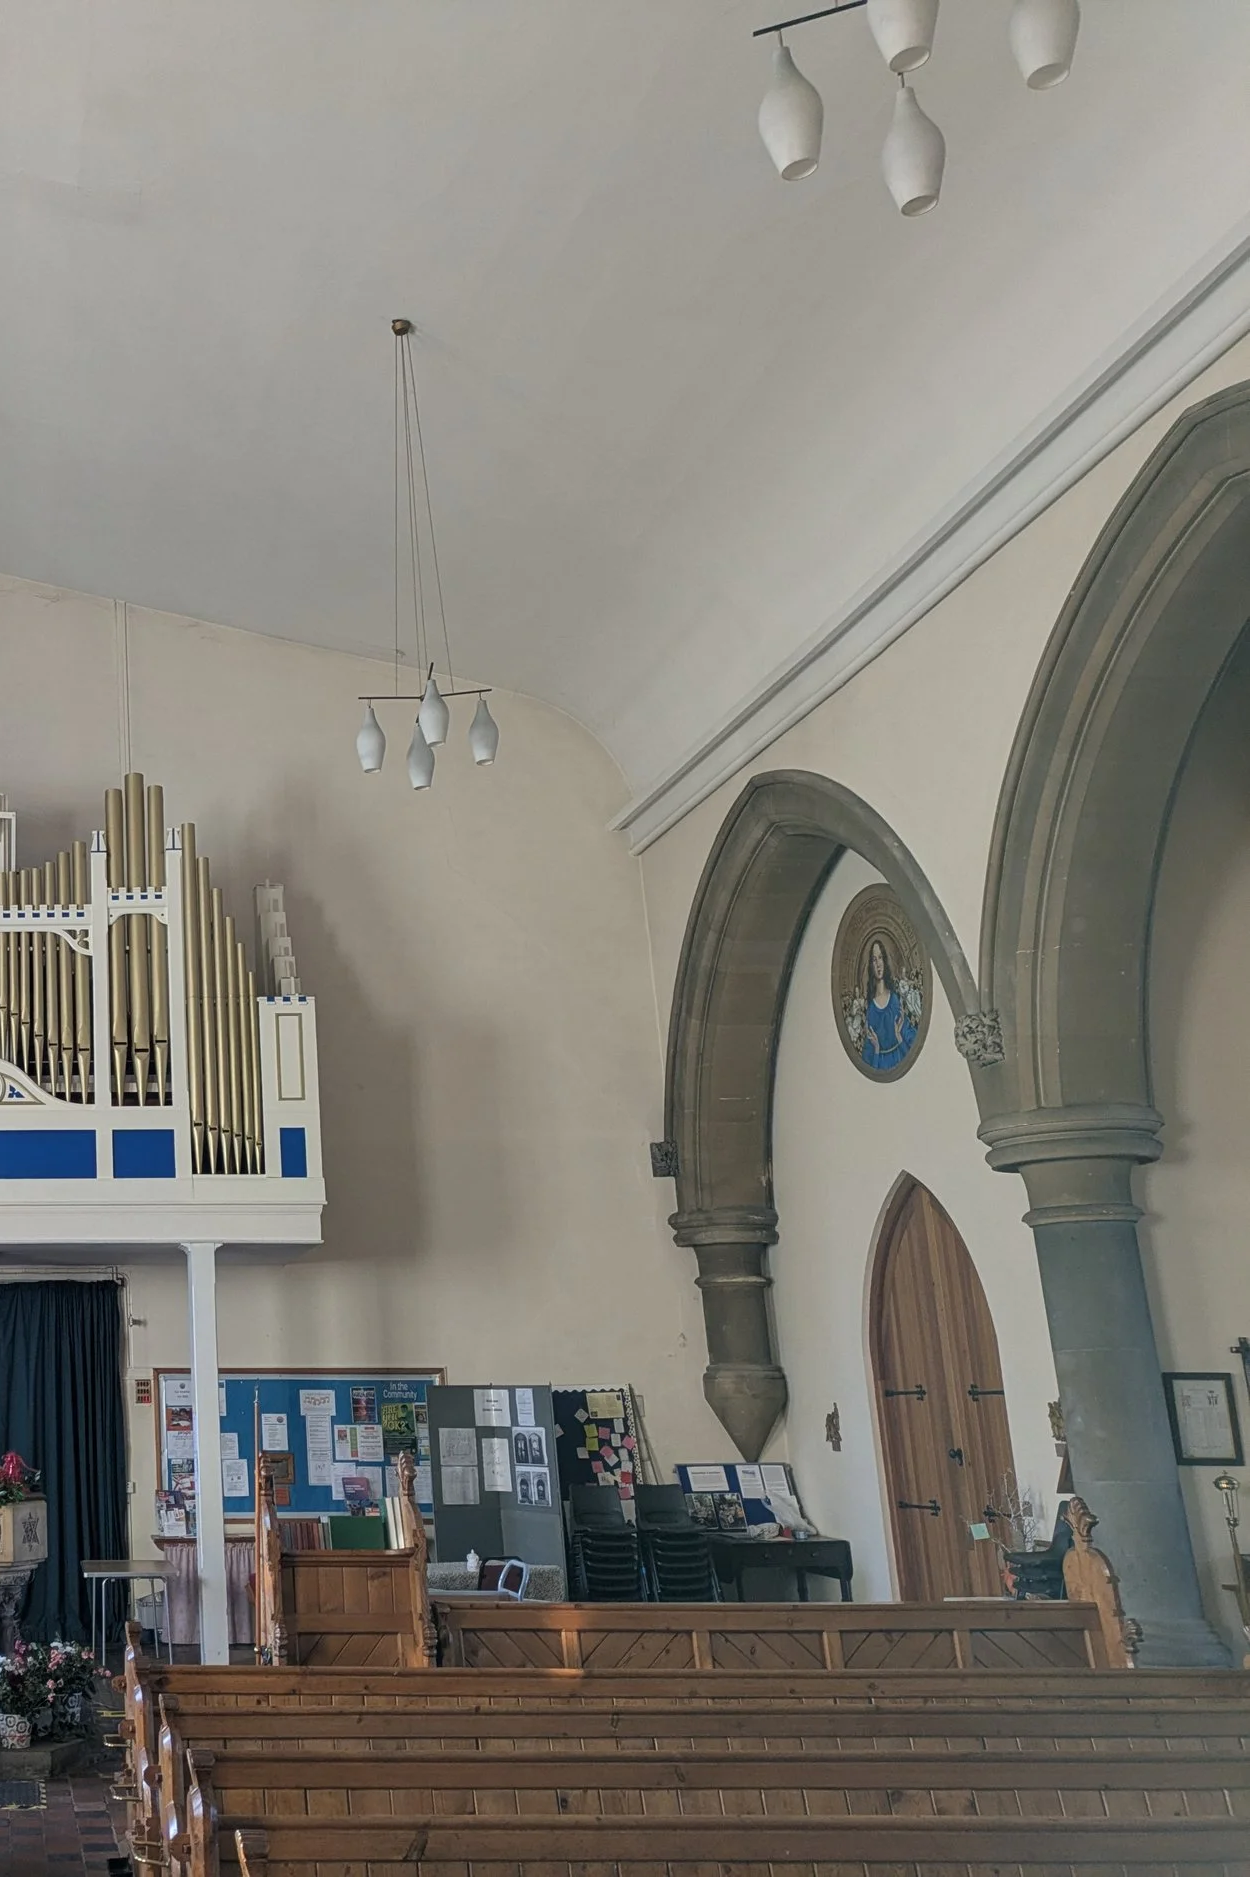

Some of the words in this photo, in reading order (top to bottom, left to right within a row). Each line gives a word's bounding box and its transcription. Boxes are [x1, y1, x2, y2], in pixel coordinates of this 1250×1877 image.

[390, 1382, 396, 1390] In
[398, 1382, 408, 1390] the
[383, 1390, 417, 1400] Community
